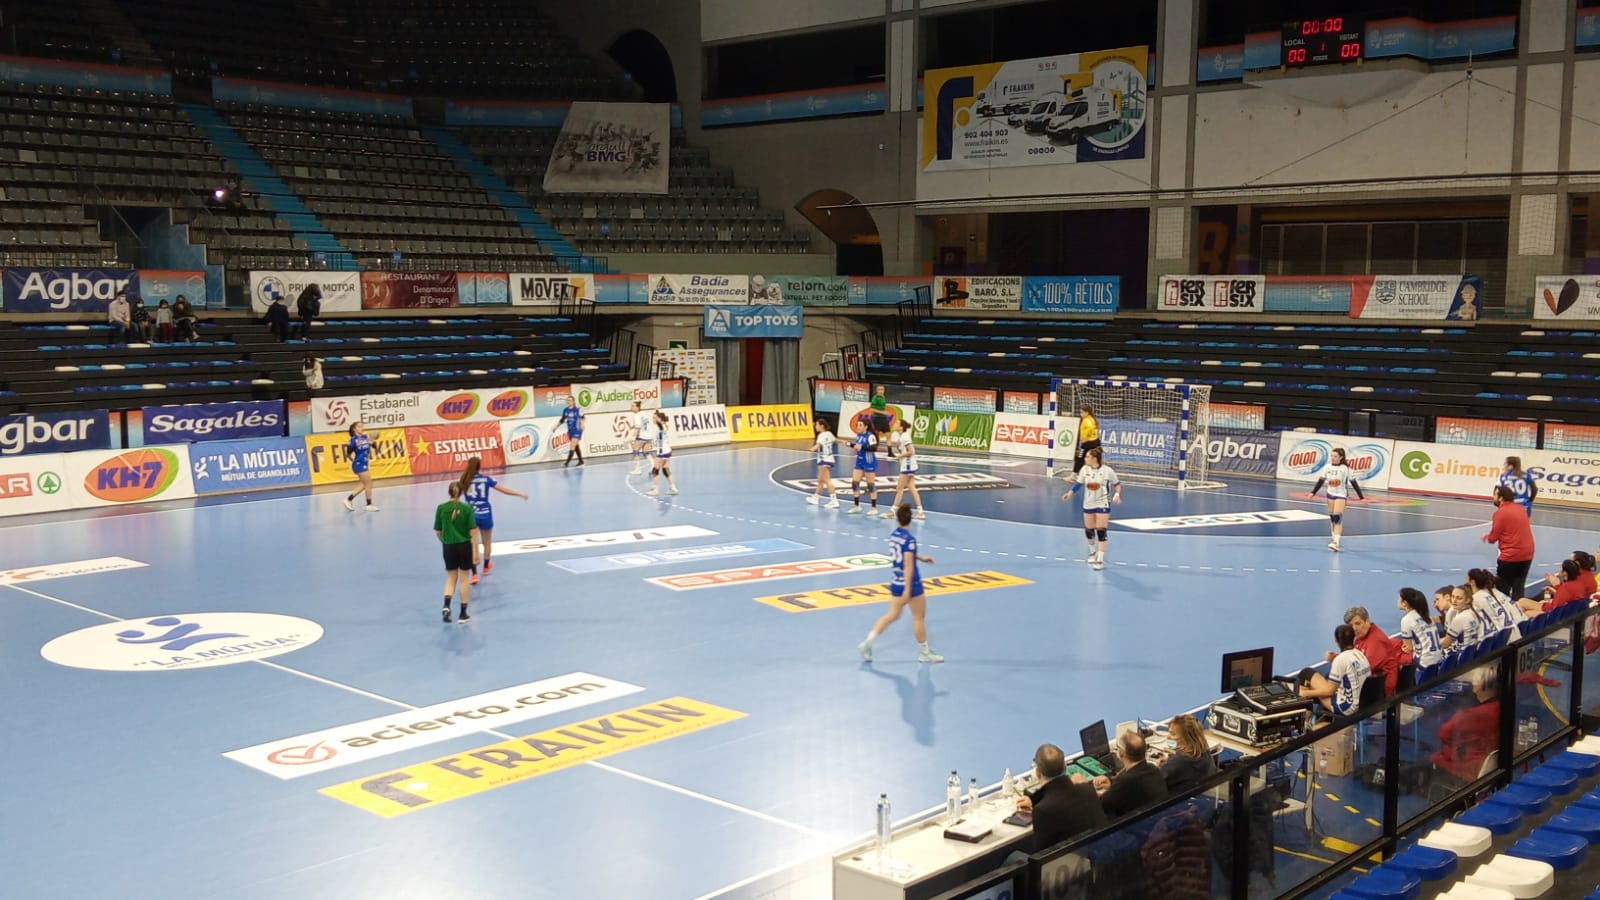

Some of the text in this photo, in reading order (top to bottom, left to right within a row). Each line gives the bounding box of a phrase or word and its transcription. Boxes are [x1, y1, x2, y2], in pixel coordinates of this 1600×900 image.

[1302, 17, 1343, 35] 00:00
[1288, 49, 1306, 63] 00
[1340, 43, 1360, 58] 00
[586, 151, 626, 162] BMG
[380, 273, 441, 282] RESTAURANT
[691, 275, 729, 287] Badia
[971, 278, 1020, 286] EDIFICACIONS
[18, 272, 129, 308] Agbar
[323, 283, 356, 292] MOTOR
[679, 287, 747, 297] Assegurances
[1042, 277, 1113, 304] 100% RÈTOLS
[1399, 281, 1447, 292] CAMBRIDGE
[1398, 294, 1431, 305] SCHOOL
[736, 315, 799, 326] TOP TOYS
[360, 395, 420, 411] Estabanell
[149, 409, 279, 434] Sagalés
[360, 410, 406, 426] Energia
[673, 411, 727, 432] FRAIKIN
[748, 410, 808, 428] FRAIKIN
[434, 437, 498, 454] ESTRELLA
[938, 434, 988, 448] IBERDROLA
[1187, 434, 1267, 463] Agbar
[454, 452, 482, 463] DAMM
[1288, 451, 1317, 467] COLON
[248, 472, 256, 480] DE
[467, 483, 487, 498] 41
[668, 560, 844, 588] SPAR
[340, 681, 606, 749] acierto.com
[432, 702, 707, 779] FRAIKIN
